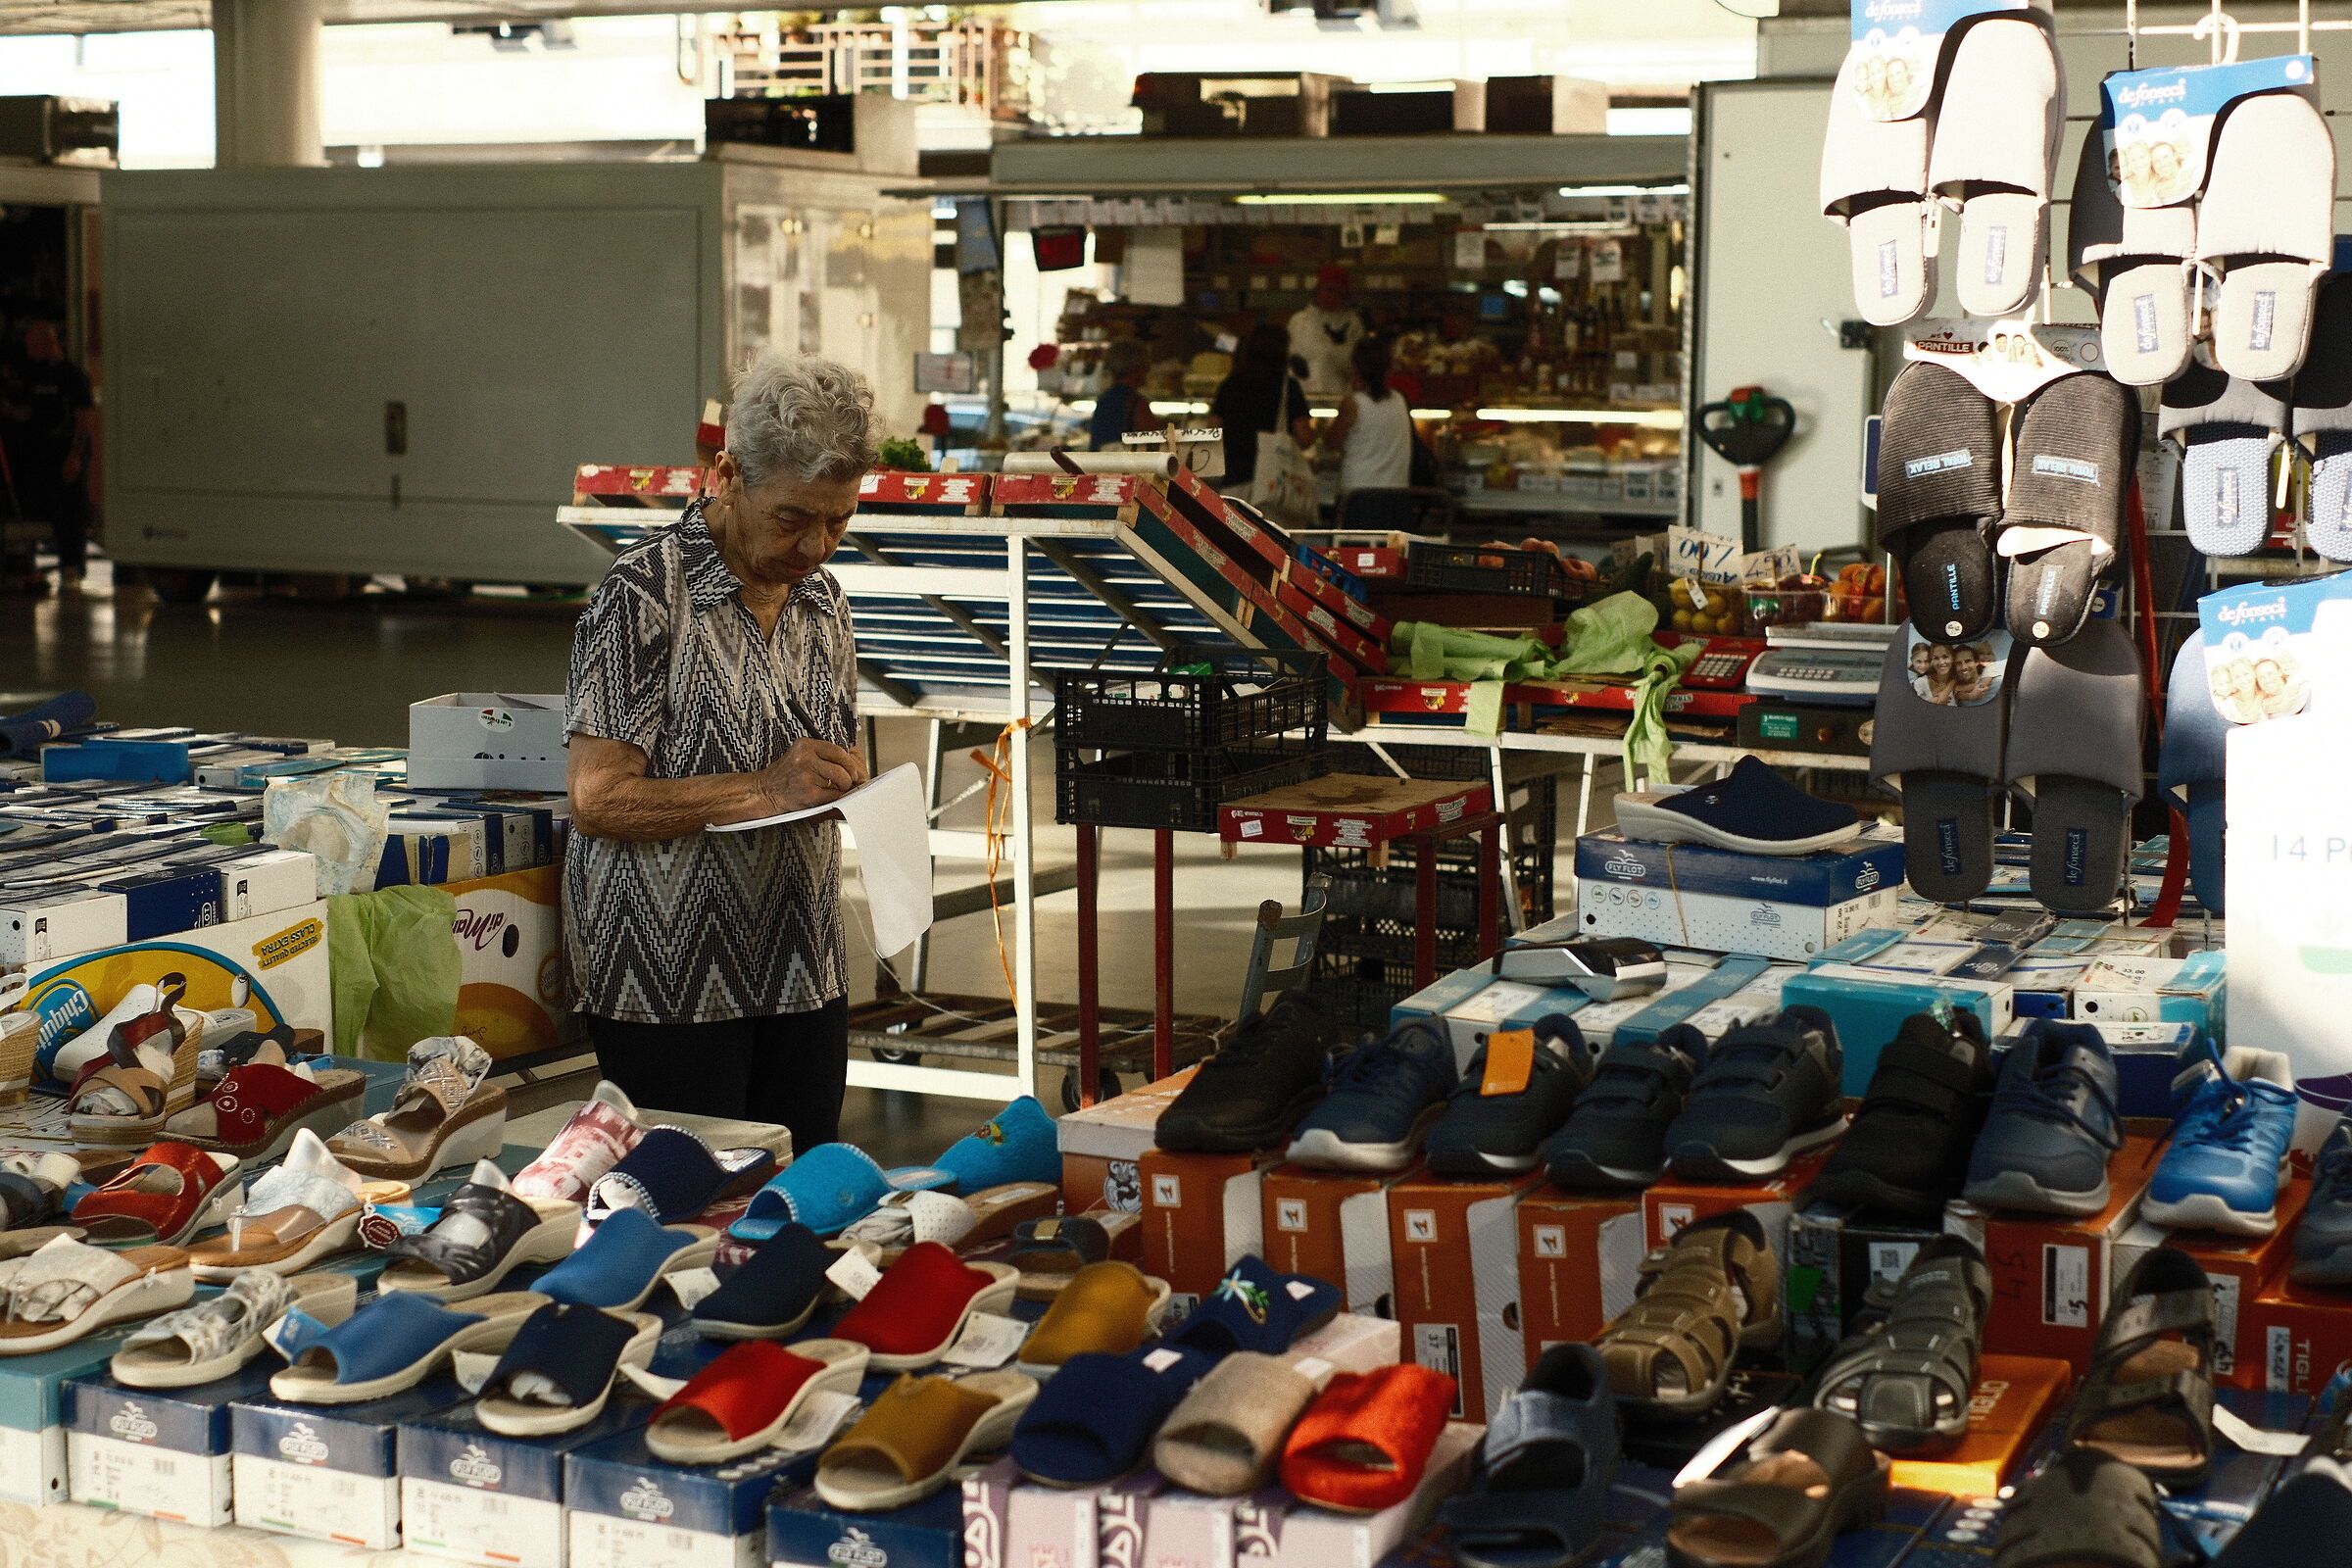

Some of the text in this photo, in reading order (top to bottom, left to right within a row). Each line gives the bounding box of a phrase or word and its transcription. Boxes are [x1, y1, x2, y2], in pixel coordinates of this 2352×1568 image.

[1918, 342, 1970, 353] PANTILLE
[1946, 564, 1961, 611] PANTILLE
[2039, 571, 2055, 615] PANTILLE
[1939, 823, 1958, 873] defonseca
[2066, 832, 2082, 883] defonseca
[2327, 837, 2352, 862] P
[1608, 863, 1642, 874] FLY FLOT
[261, 923, 316, 956] CLASS EXTRA
[262, 934, 318, 968] SELECTED QUALITY
[36, 990, 89, 1052] Chiquit
